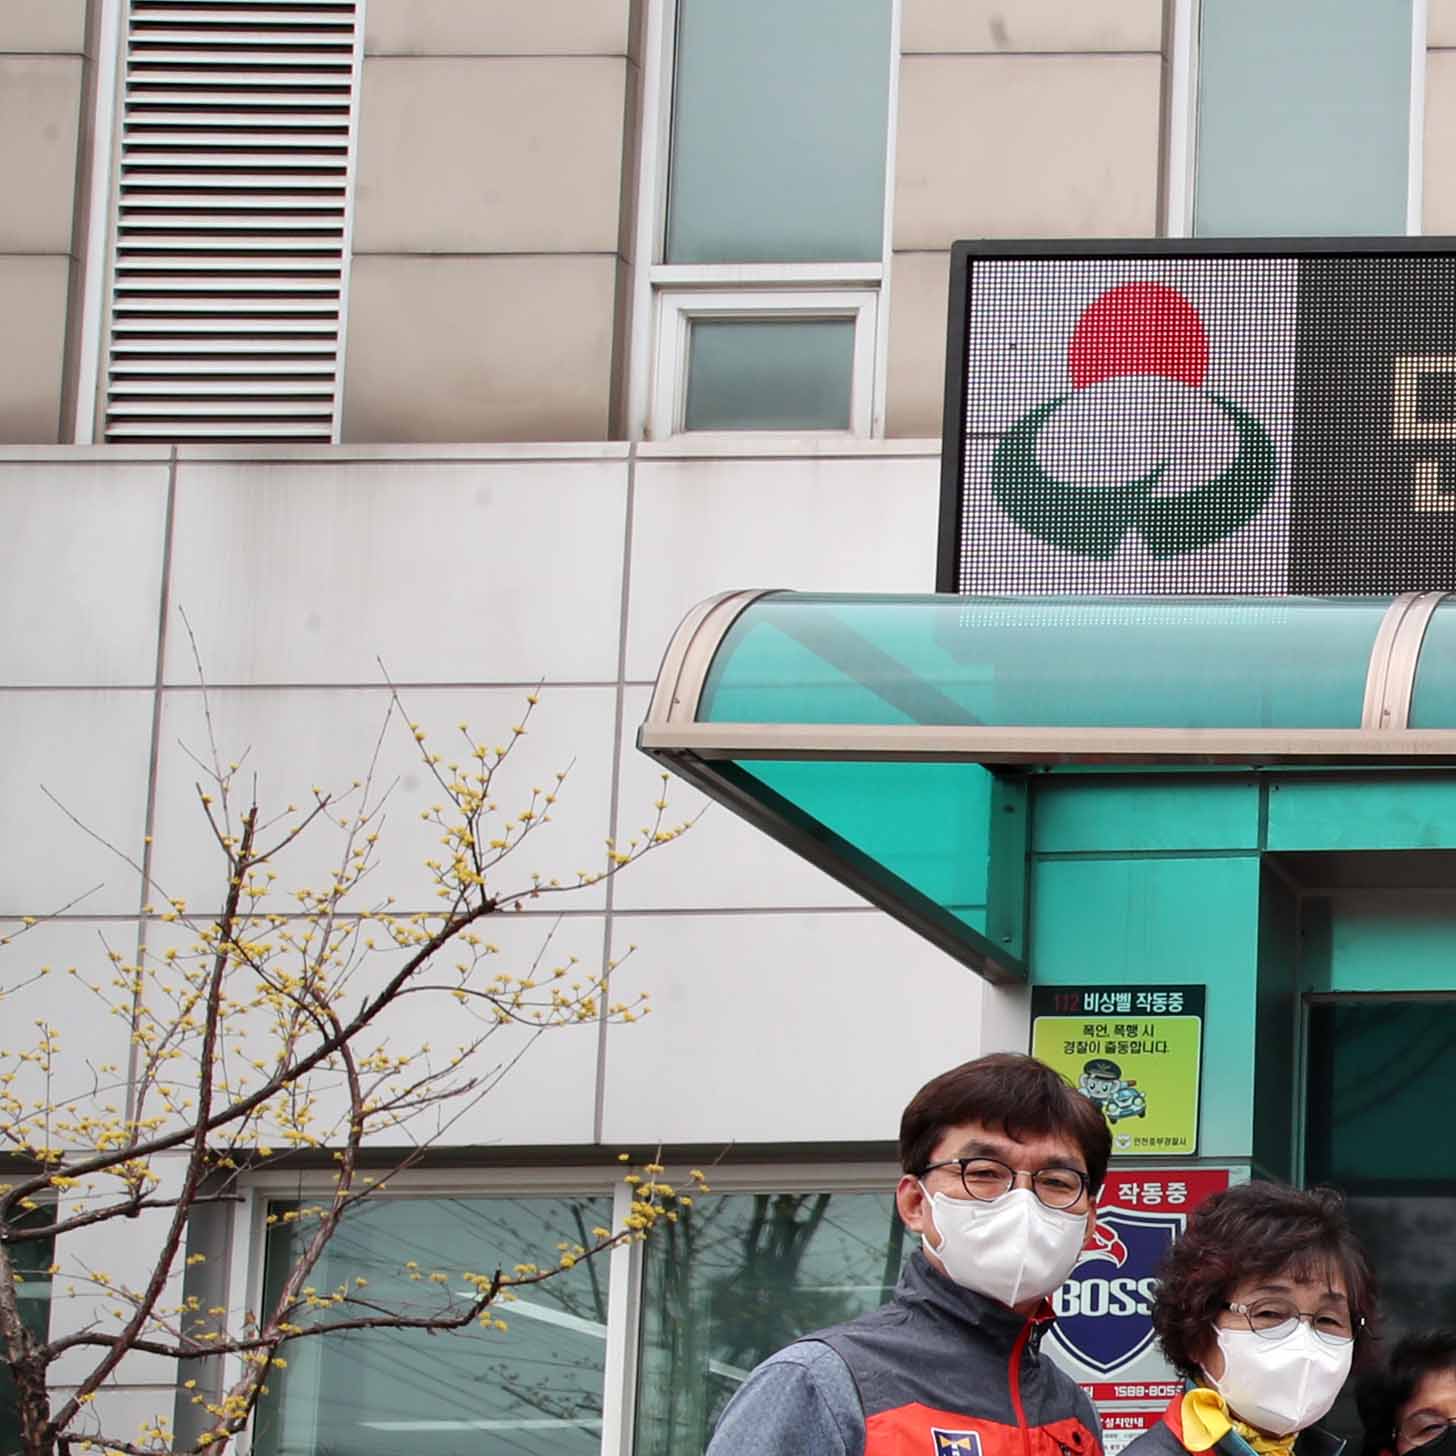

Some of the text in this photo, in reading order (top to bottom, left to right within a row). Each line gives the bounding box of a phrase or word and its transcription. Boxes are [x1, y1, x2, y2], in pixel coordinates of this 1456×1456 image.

[1084, 992, 1131, 1012] 비상벨
[1136, 992, 1183, 1012] 작동중
[1142, 1024, 1154, 1037] 시
[1064, 1041, 1100, 1054] 경찰이
[1118, 1182, 1188, 1204] 작동중
